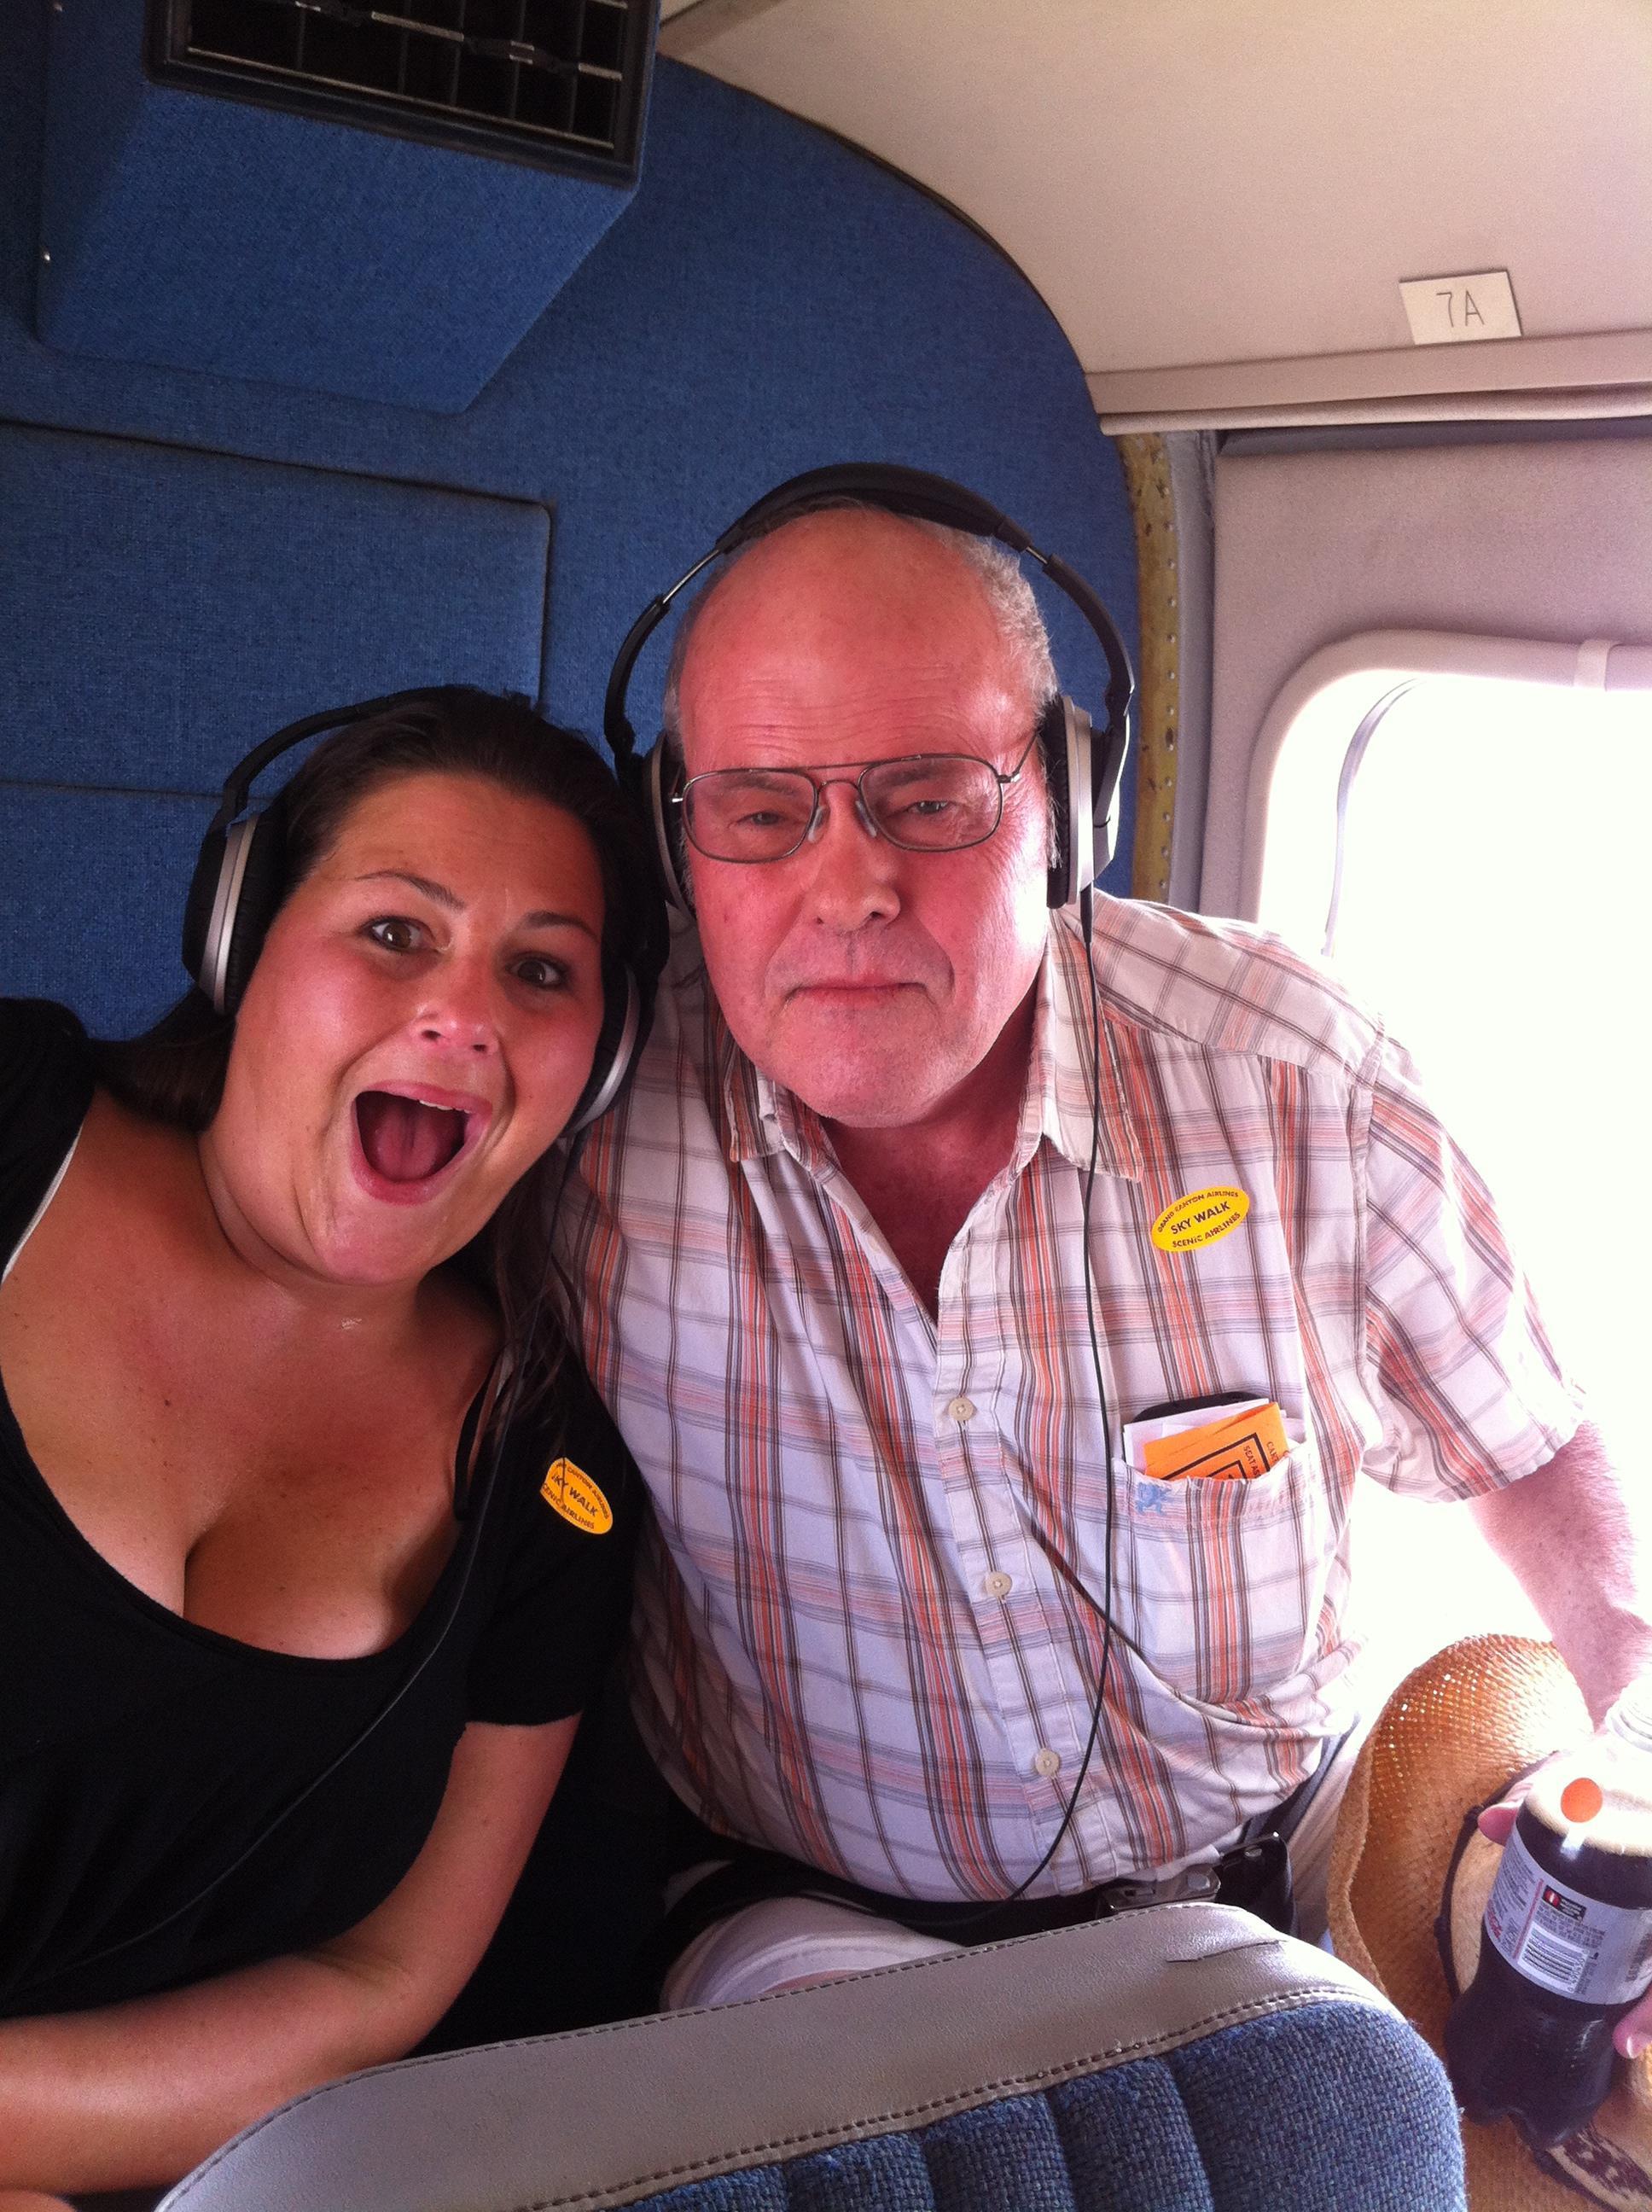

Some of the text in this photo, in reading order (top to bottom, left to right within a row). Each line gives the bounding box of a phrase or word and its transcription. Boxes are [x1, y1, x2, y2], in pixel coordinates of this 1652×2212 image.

[1436, 290, 1485, 328] 7A
[1206, 1190, 1239, 1199] AIRLINES
[1171, 1201, 1230, 1234] SKY WALK
[1172, 1211, 1242, 1249] SCENIC AIRLINES
[1243, 1445, 1257, 1465] SEAT
[542, 1483, 561, 1505] CENIC
[569, 1487, 599, 1517] WALK
